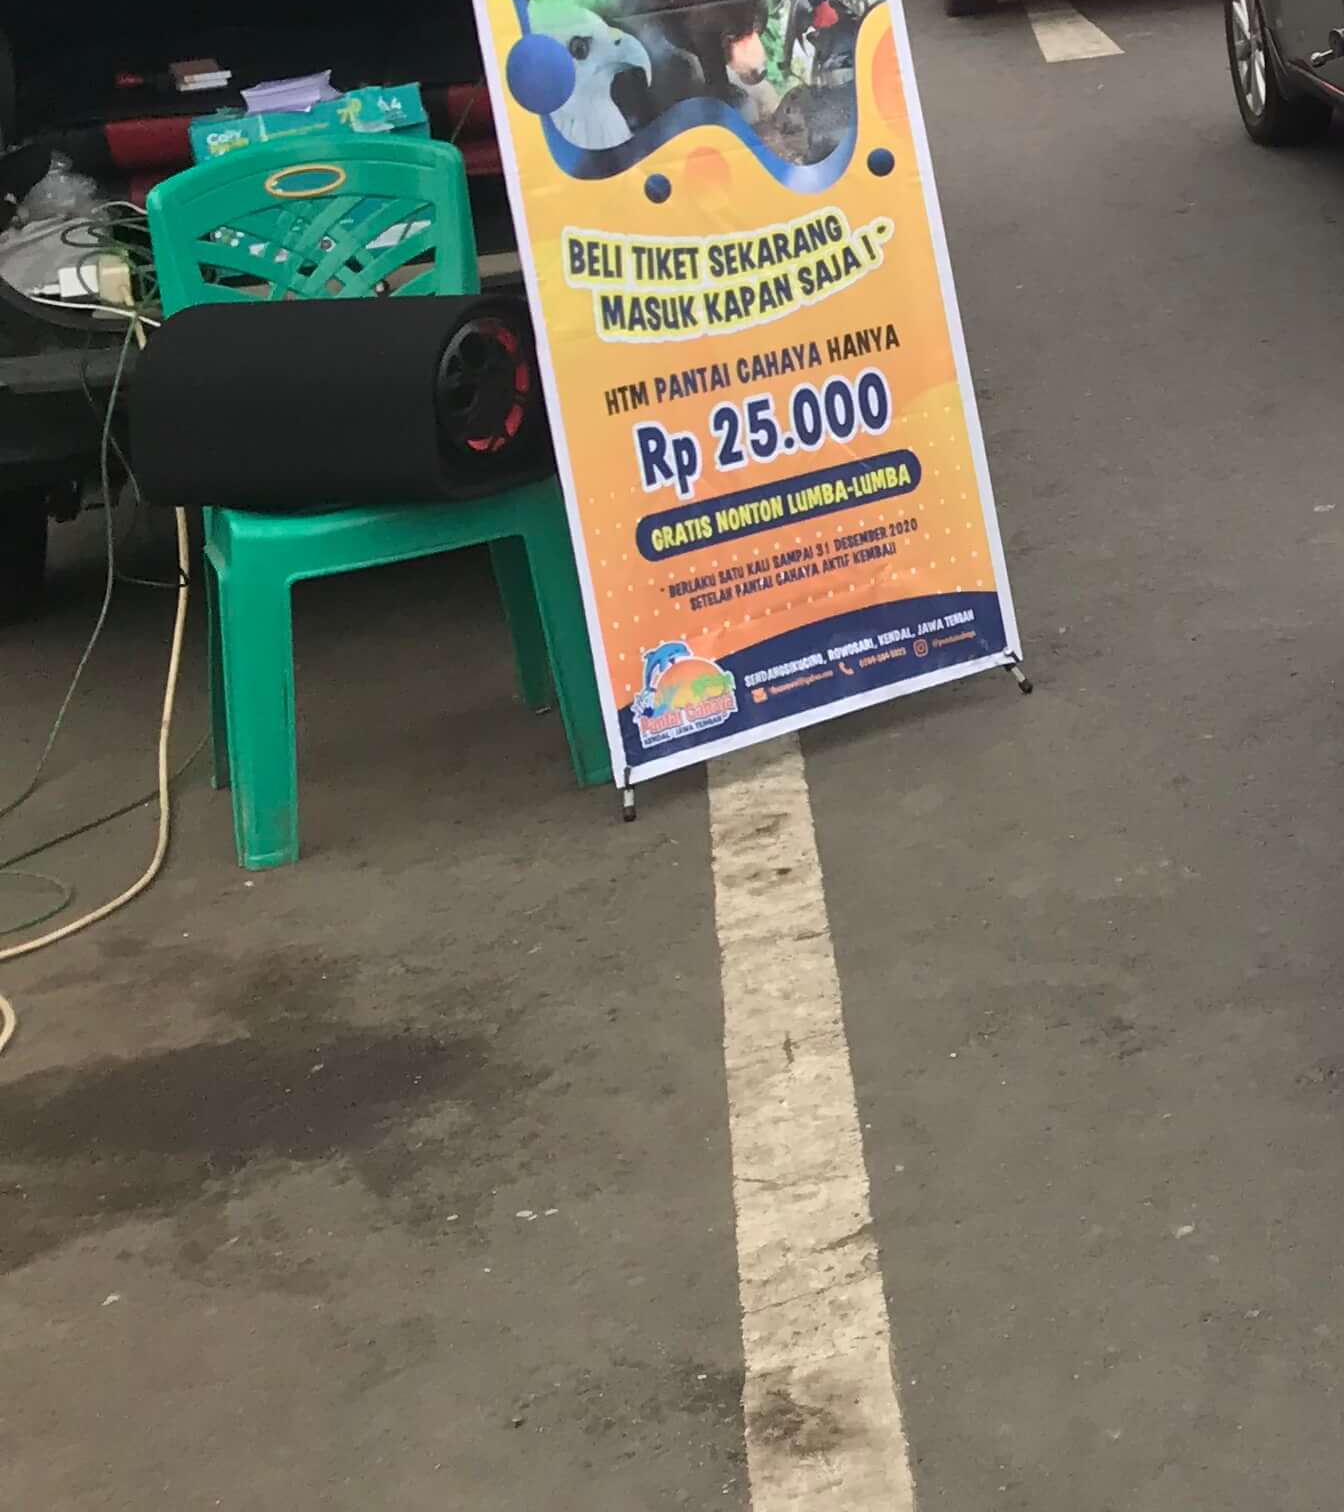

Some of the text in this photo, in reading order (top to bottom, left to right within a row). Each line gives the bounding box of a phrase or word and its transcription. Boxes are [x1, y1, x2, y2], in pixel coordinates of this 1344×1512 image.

[567, 214, 845, 282] BELI TIKET SEKARANG
[600, 293, 698, 333] MASUK
[704, 281, 794, 327] KAPAN
[799, 252, 863, 296] SAJA
[603, 324, 902, 416] HTM PANTAI CAHAYA HANYA
[637, 370, 892, 497] Rp 25.000
[650, 463, 911, 553] GRATIS NONTON LUMBA-LUMBA
[668, 574, 716, 599] BERLAKU
[718, 568, 744, 585] SATU
[772, 550, 814, 573] SAMPAI
[815, 541, 830, 558] 31
[833, 526, 888, 552] DESEMBER
[888, 517, 919, 538] 2020
[690, 587, 732, 611] SETELAH
[735, 575, 775, 599] PANTAI
[775, 564, 820, 587] CAHAYA
[822, 554, 850, 573] AKTIF
[876, 626, 916, 646] KENDAL,
[917, 617, 945, 636] JAWA
